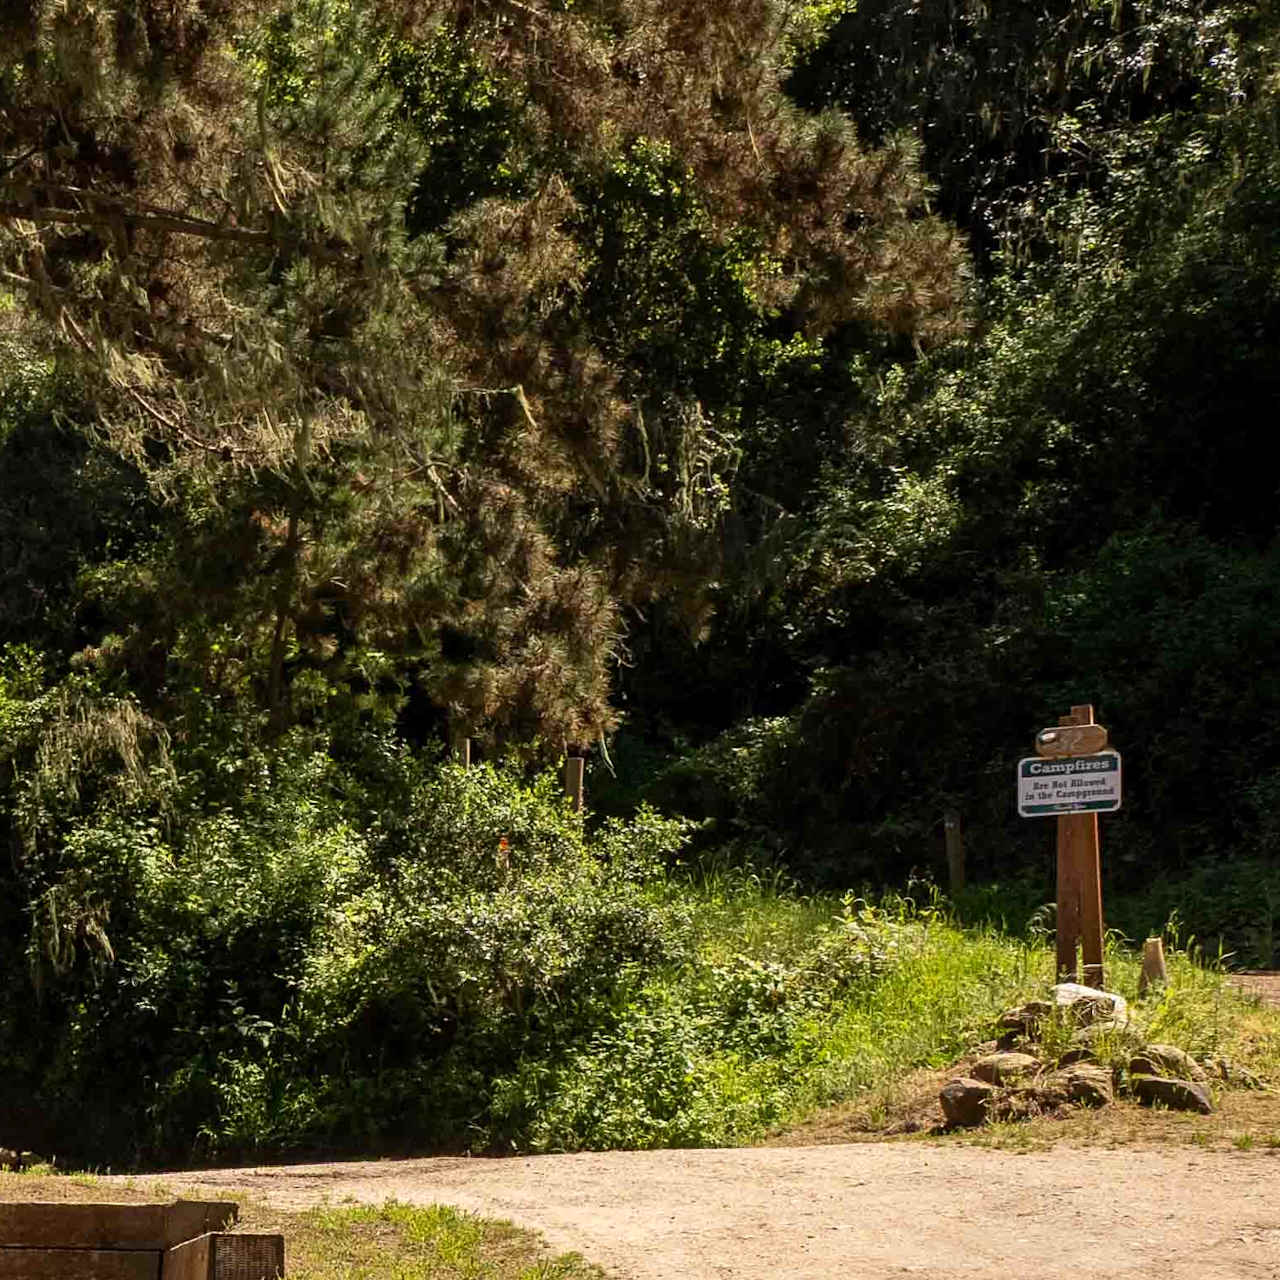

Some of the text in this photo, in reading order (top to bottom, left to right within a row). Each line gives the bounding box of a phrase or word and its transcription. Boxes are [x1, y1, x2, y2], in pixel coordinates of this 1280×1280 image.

[1030, 760, 1110, 774] Campfires
[1052, 780, 1067, 789] Not
[1071, 777, 1106, 788] Allowed
[1024, 787, 1114, 801] in the Campground
